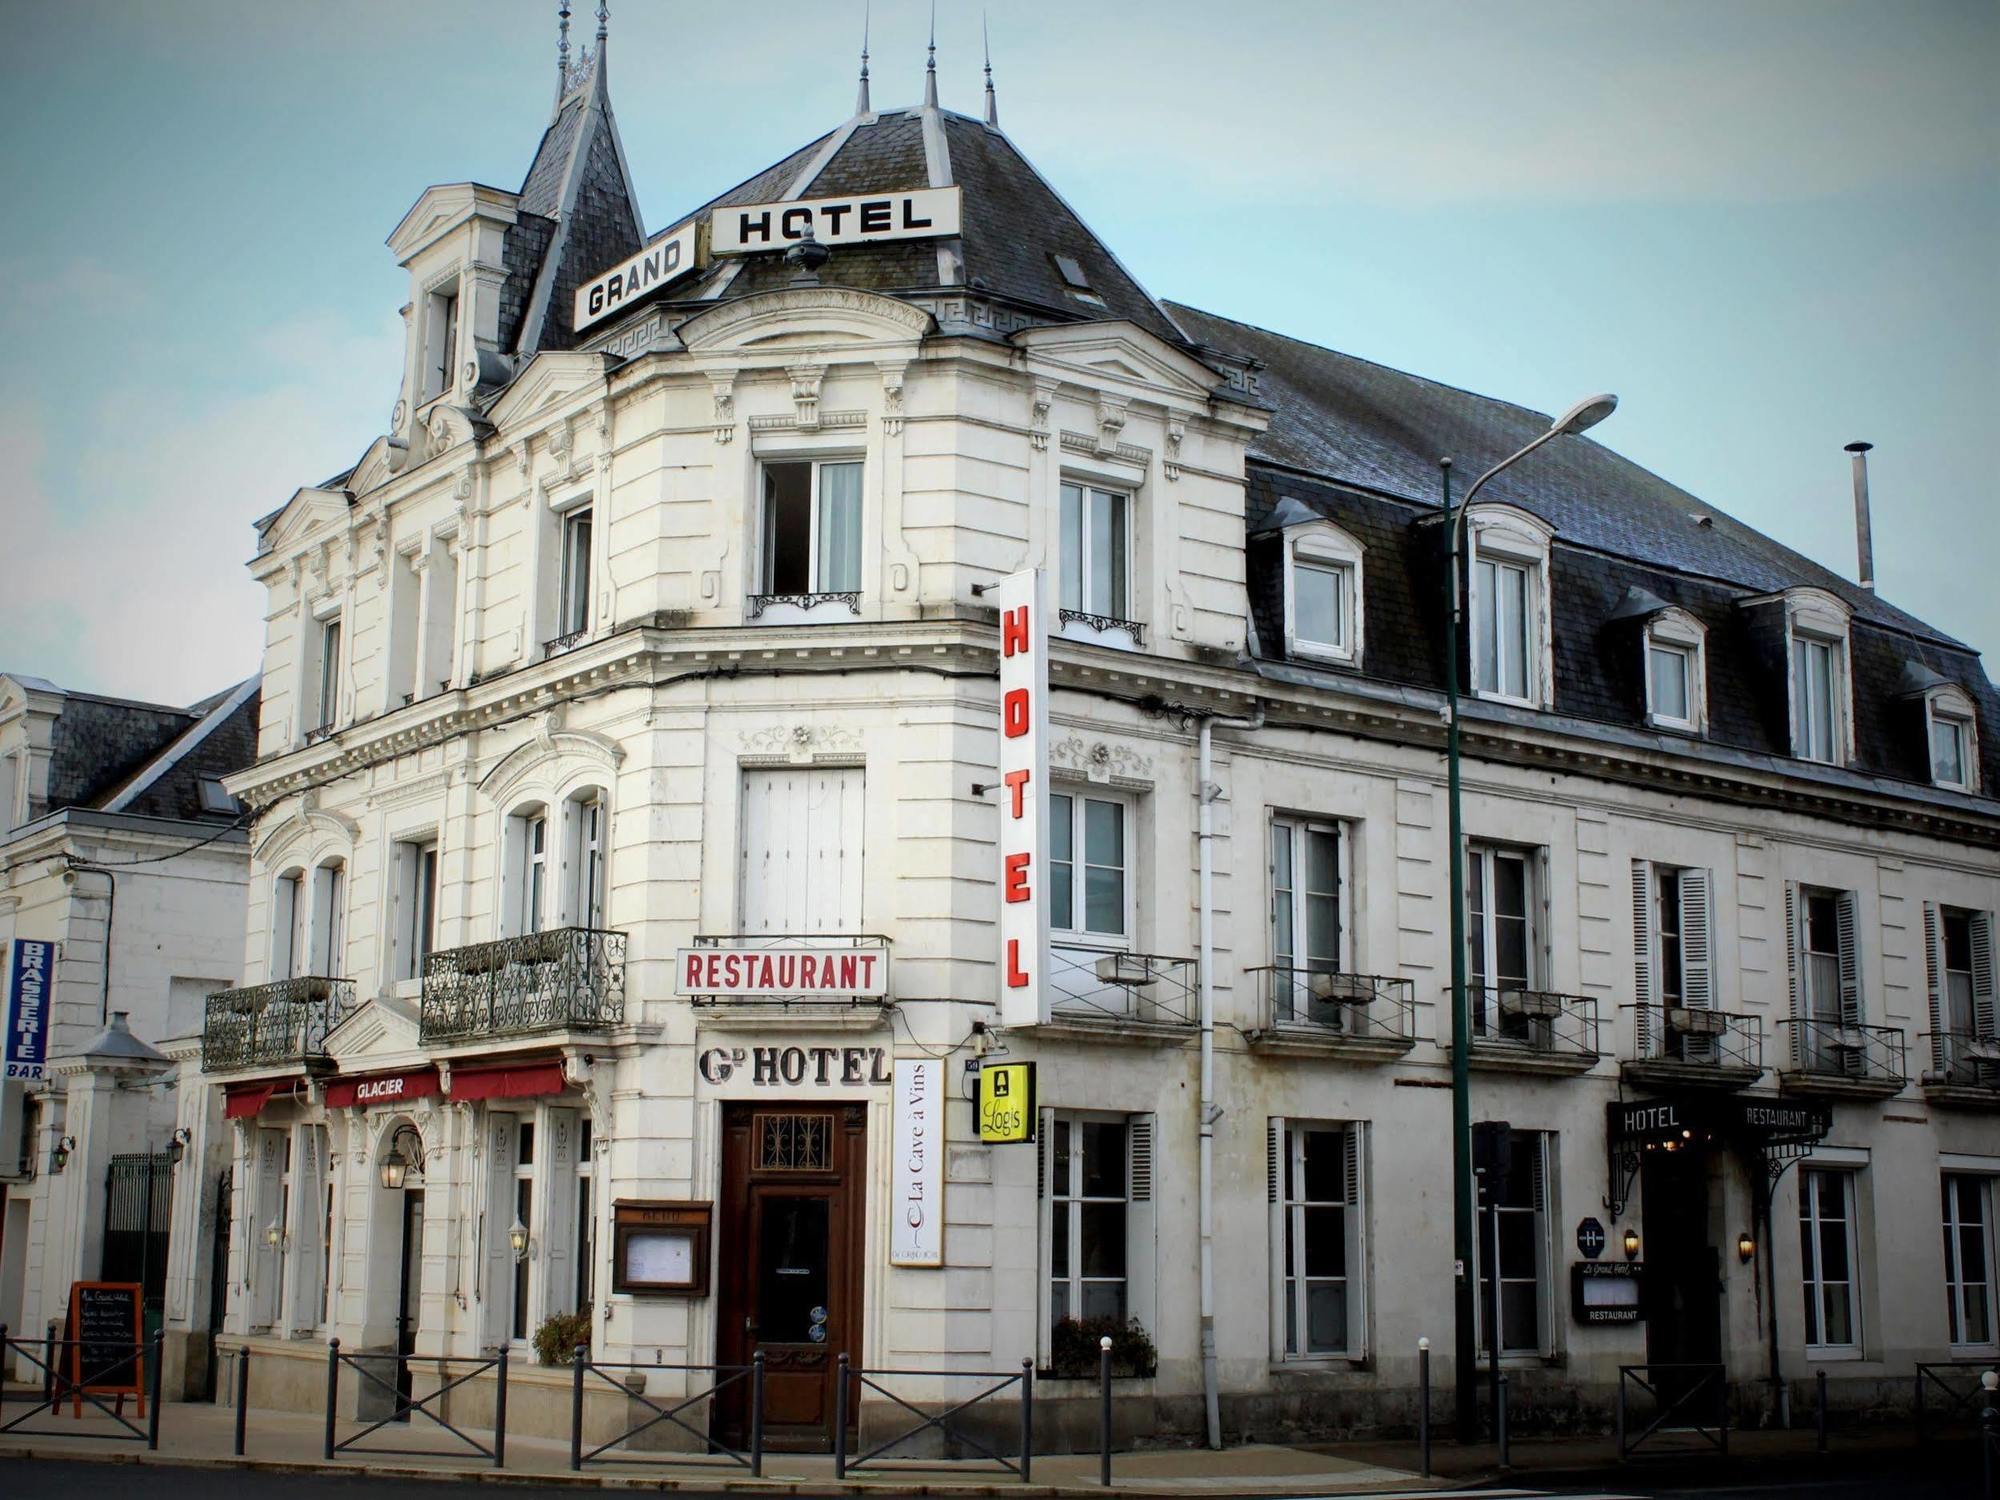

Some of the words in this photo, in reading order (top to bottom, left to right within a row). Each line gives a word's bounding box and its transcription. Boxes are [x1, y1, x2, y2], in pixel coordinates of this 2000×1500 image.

[739, 199, 932, 244] HOTEL
[588, 239, 680, 316] GRAND
[1003, 604, 1030, 988] HOTEL
[686, 954, 877, 989] RESTAURANT
[17, 942, 45, 1059] BRASSERIE
[7, 1064, 43, 1080] BAR
[752, 1046, 893, 1086] HOTEL
[357, 1078, 404, 1099] GLACIER
[908, 1064, 925, 1106] Vins
[907, 1111, 924, 1120] à
[982, 1099, 1021, 1136] Logis
[1625, 1106, 1680, 1133] HOTEL
[1746, 1107, 1807, 1128] RESTAURANT
[908, 1127, 924, 1174] Cave
[908, 1182, 923, 1202] La
[1589, 1310, 1638, 1320] RESTAURANT
